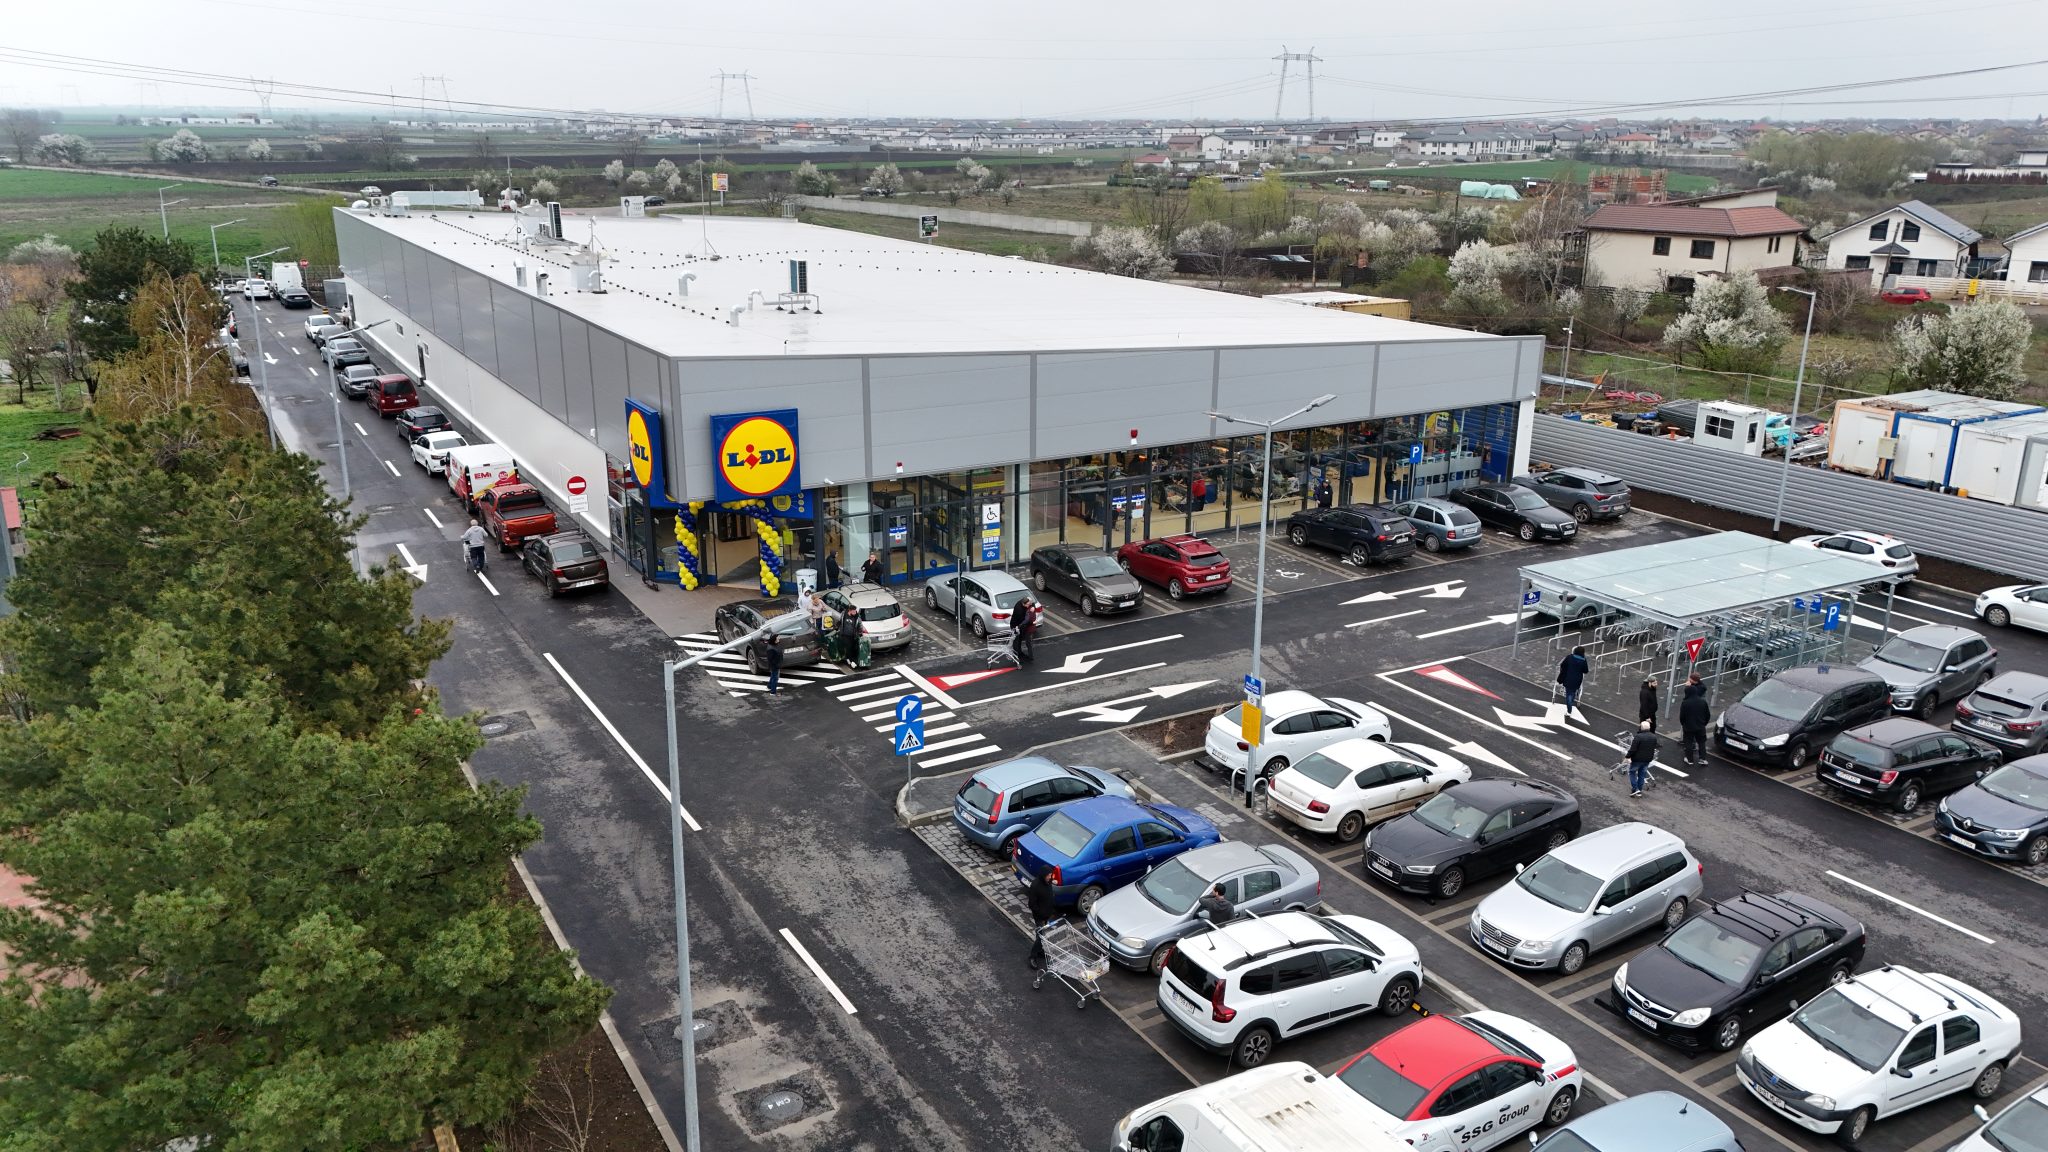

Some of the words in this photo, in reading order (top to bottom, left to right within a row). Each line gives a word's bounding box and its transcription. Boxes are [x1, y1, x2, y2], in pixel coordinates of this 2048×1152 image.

[726, 443, 791, 469] LIDL
[1412, 446, 1420, 458] P
[1827, 606, 1838, 623] P
[1461, 1120, 1493, 1144] SSG
[1498, 1104, 1530, 1125] Group
